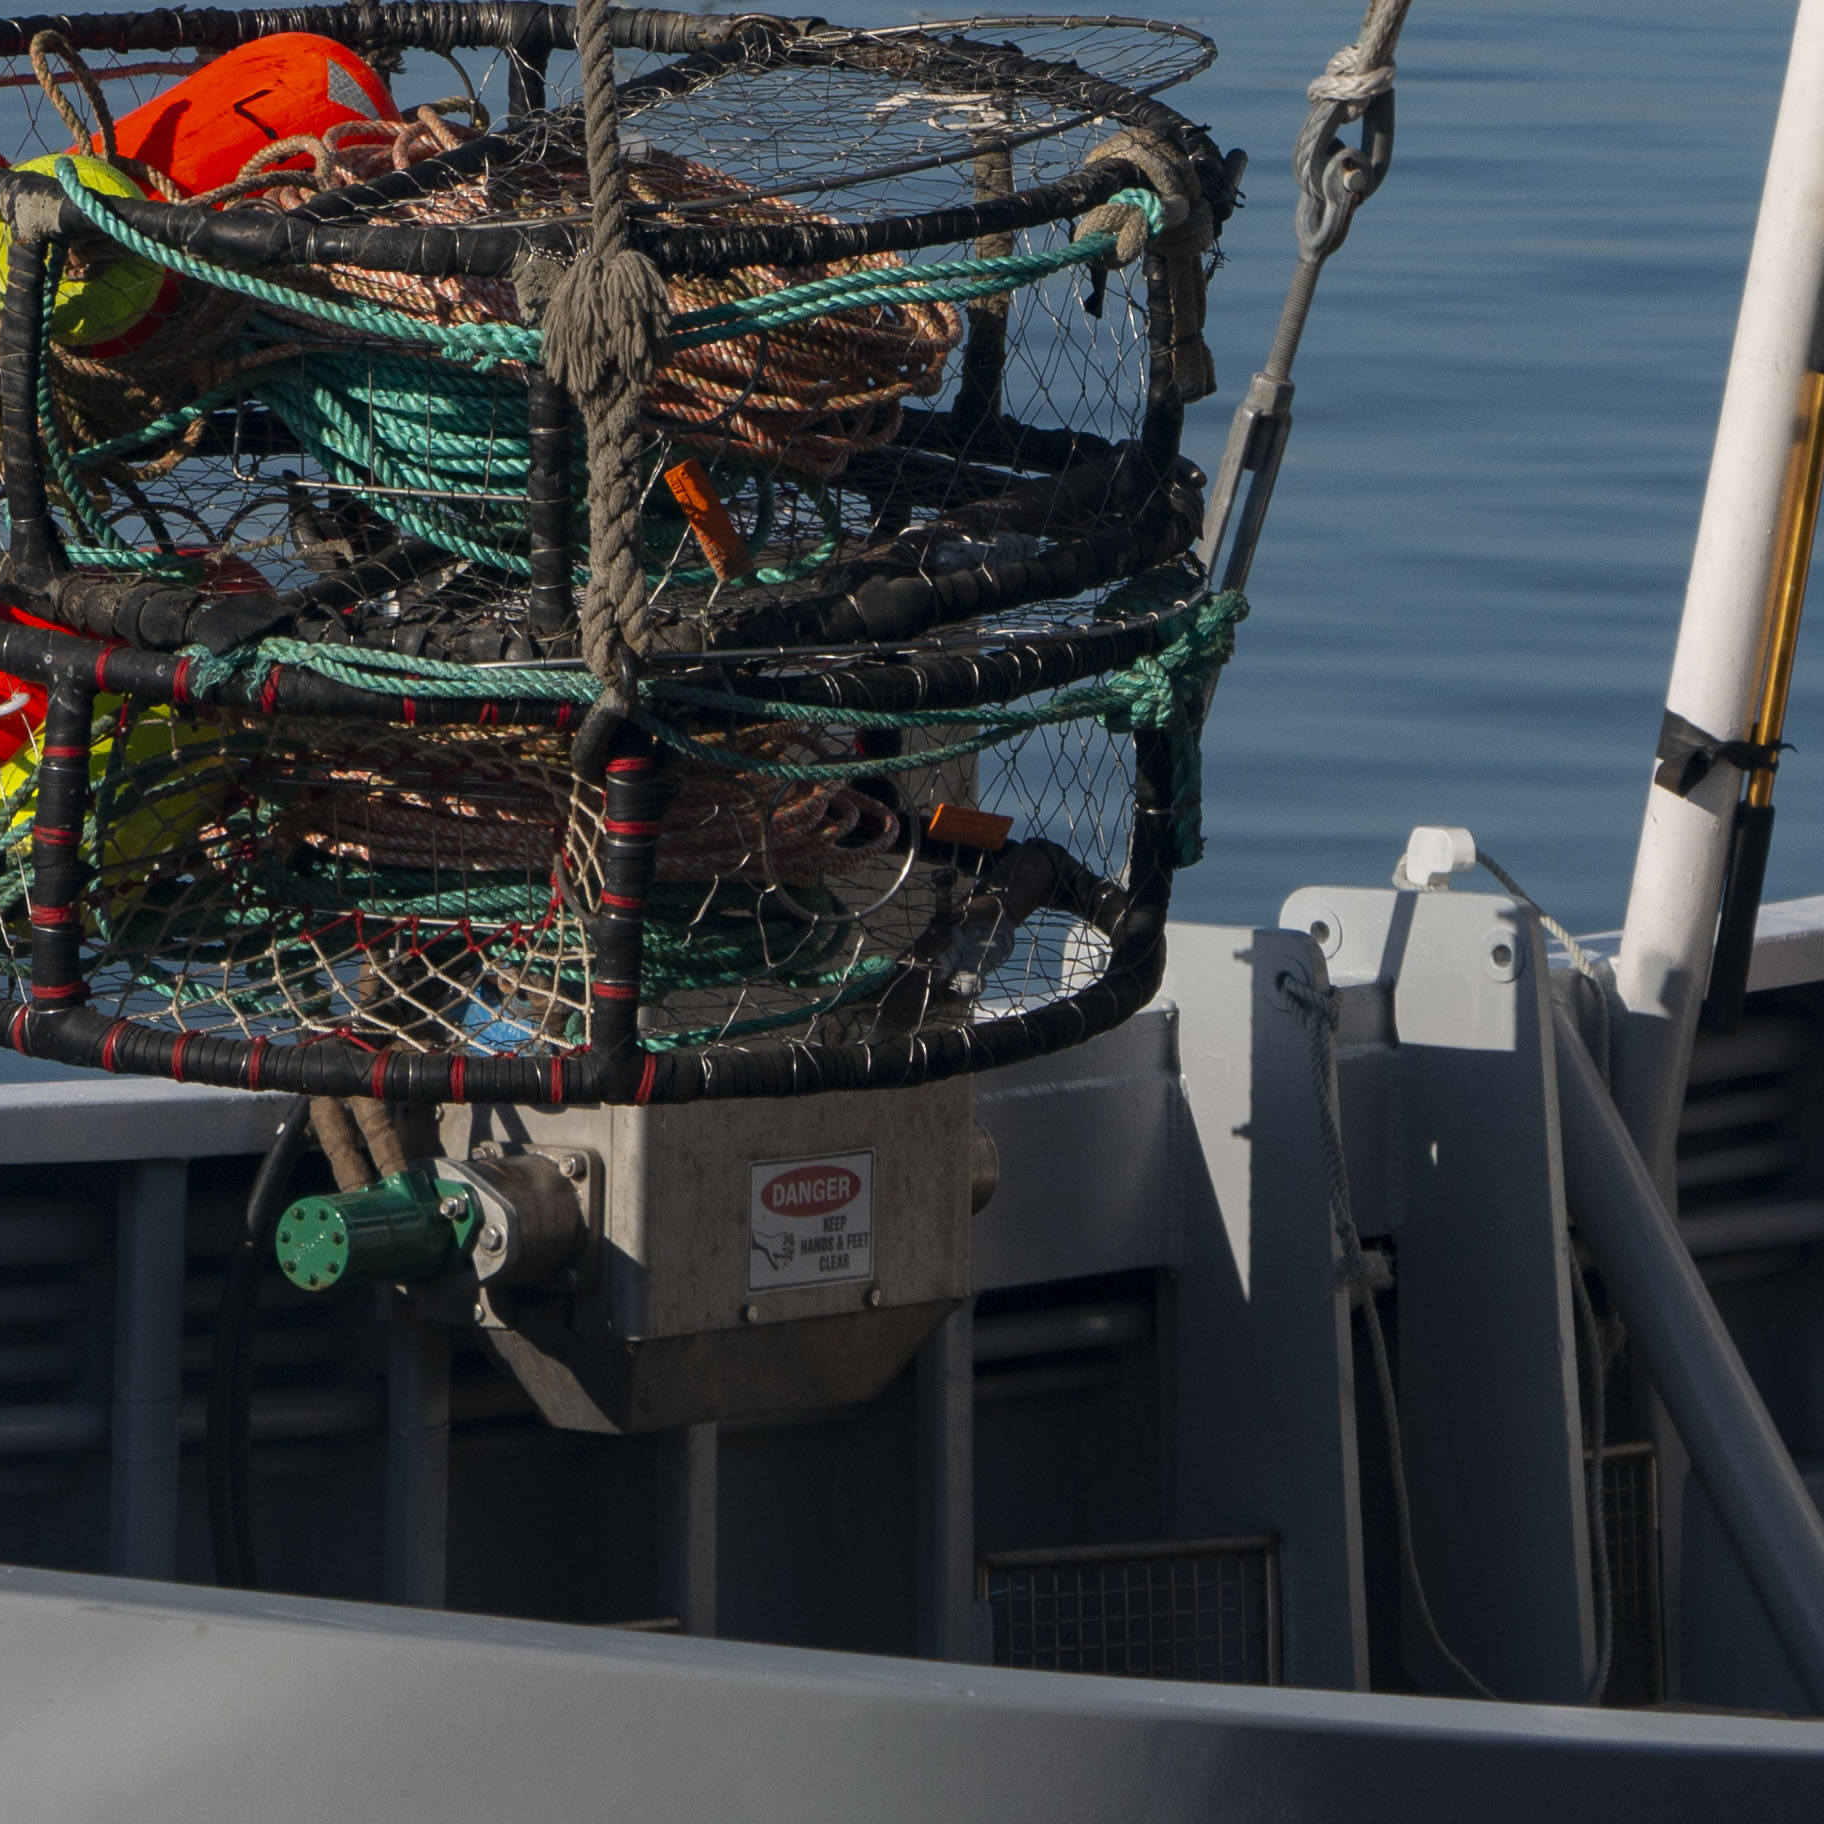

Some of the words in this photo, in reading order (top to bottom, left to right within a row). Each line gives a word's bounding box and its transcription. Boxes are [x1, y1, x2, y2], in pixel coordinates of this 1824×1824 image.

[772, 1175, 852, 1207] DANGER
[823, 1215, 847, 1233] KEEP
[800, 1236, 834, 1255] HANDS
[837, 1236, 844, 1249] &
[847, 1233, 869, 1249] FEET
[819, 1254, 850, 1273] CLEAR
